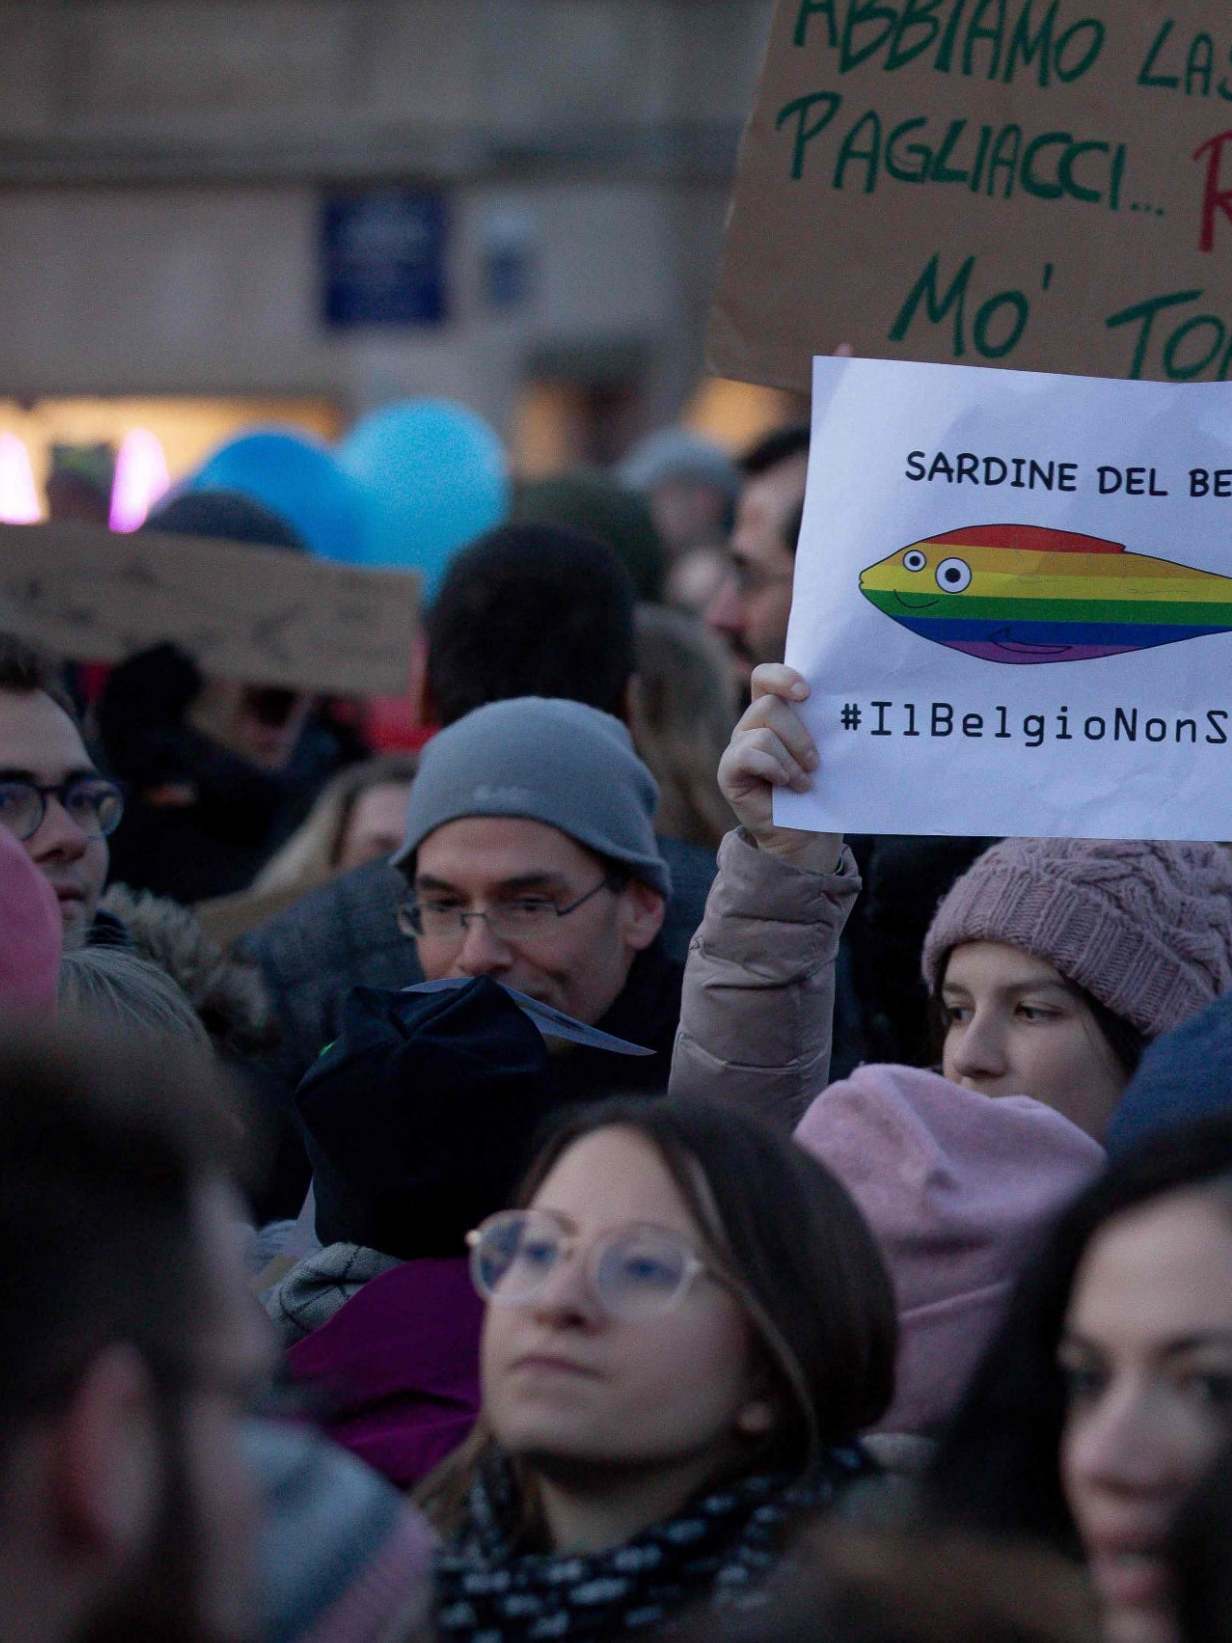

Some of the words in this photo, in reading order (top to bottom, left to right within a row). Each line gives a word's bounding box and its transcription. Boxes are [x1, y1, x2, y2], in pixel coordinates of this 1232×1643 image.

[792, 0, 1106, 88] ABBIAMO
[888, 251, 1053, 359] MO'
[904, 449, 1079, 493] SARDINE
[1096, 464, 1170, 497] DEL
